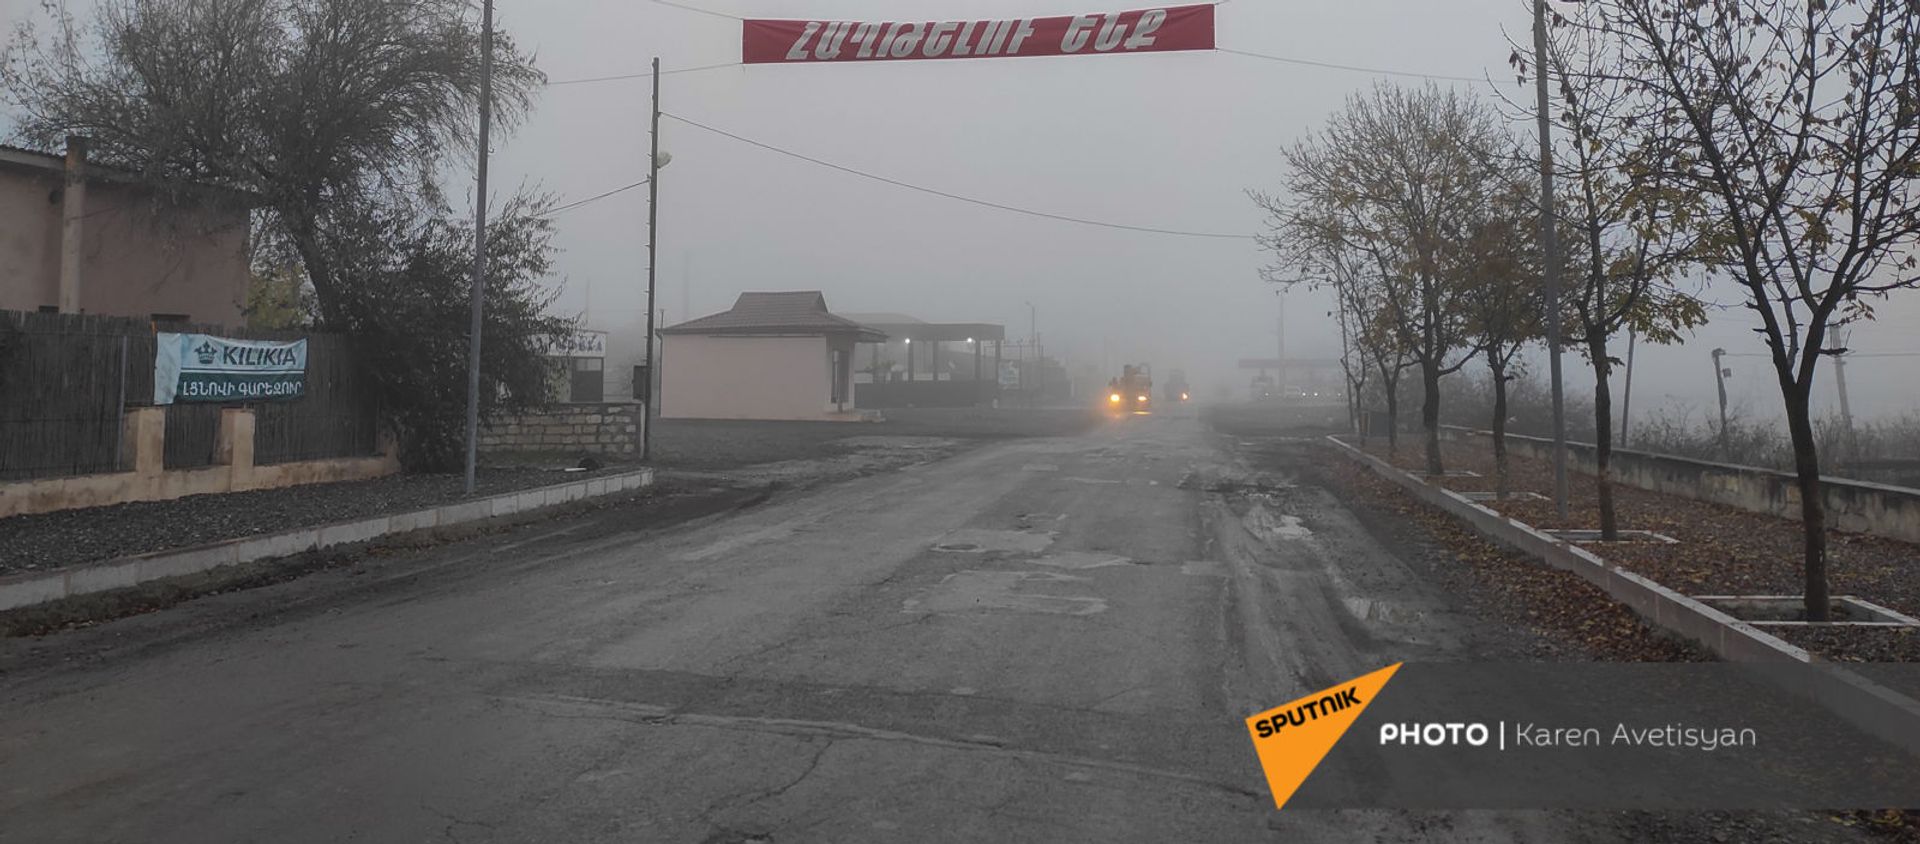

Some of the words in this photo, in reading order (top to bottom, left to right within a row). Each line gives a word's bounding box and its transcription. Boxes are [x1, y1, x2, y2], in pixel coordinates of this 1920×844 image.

[785, 19, 1035, 60] ՀԱՂԹԵԼՈՒ
[1060, 9, 1167, 53] ԵՆՔ
[223, 346, 297, 366] KILIKIA
[182, 381, 236, 396] ԼՑՆՈՎԻ
[238, 381, 302, 396] ԳԱՐԵՋՈՒՐ
